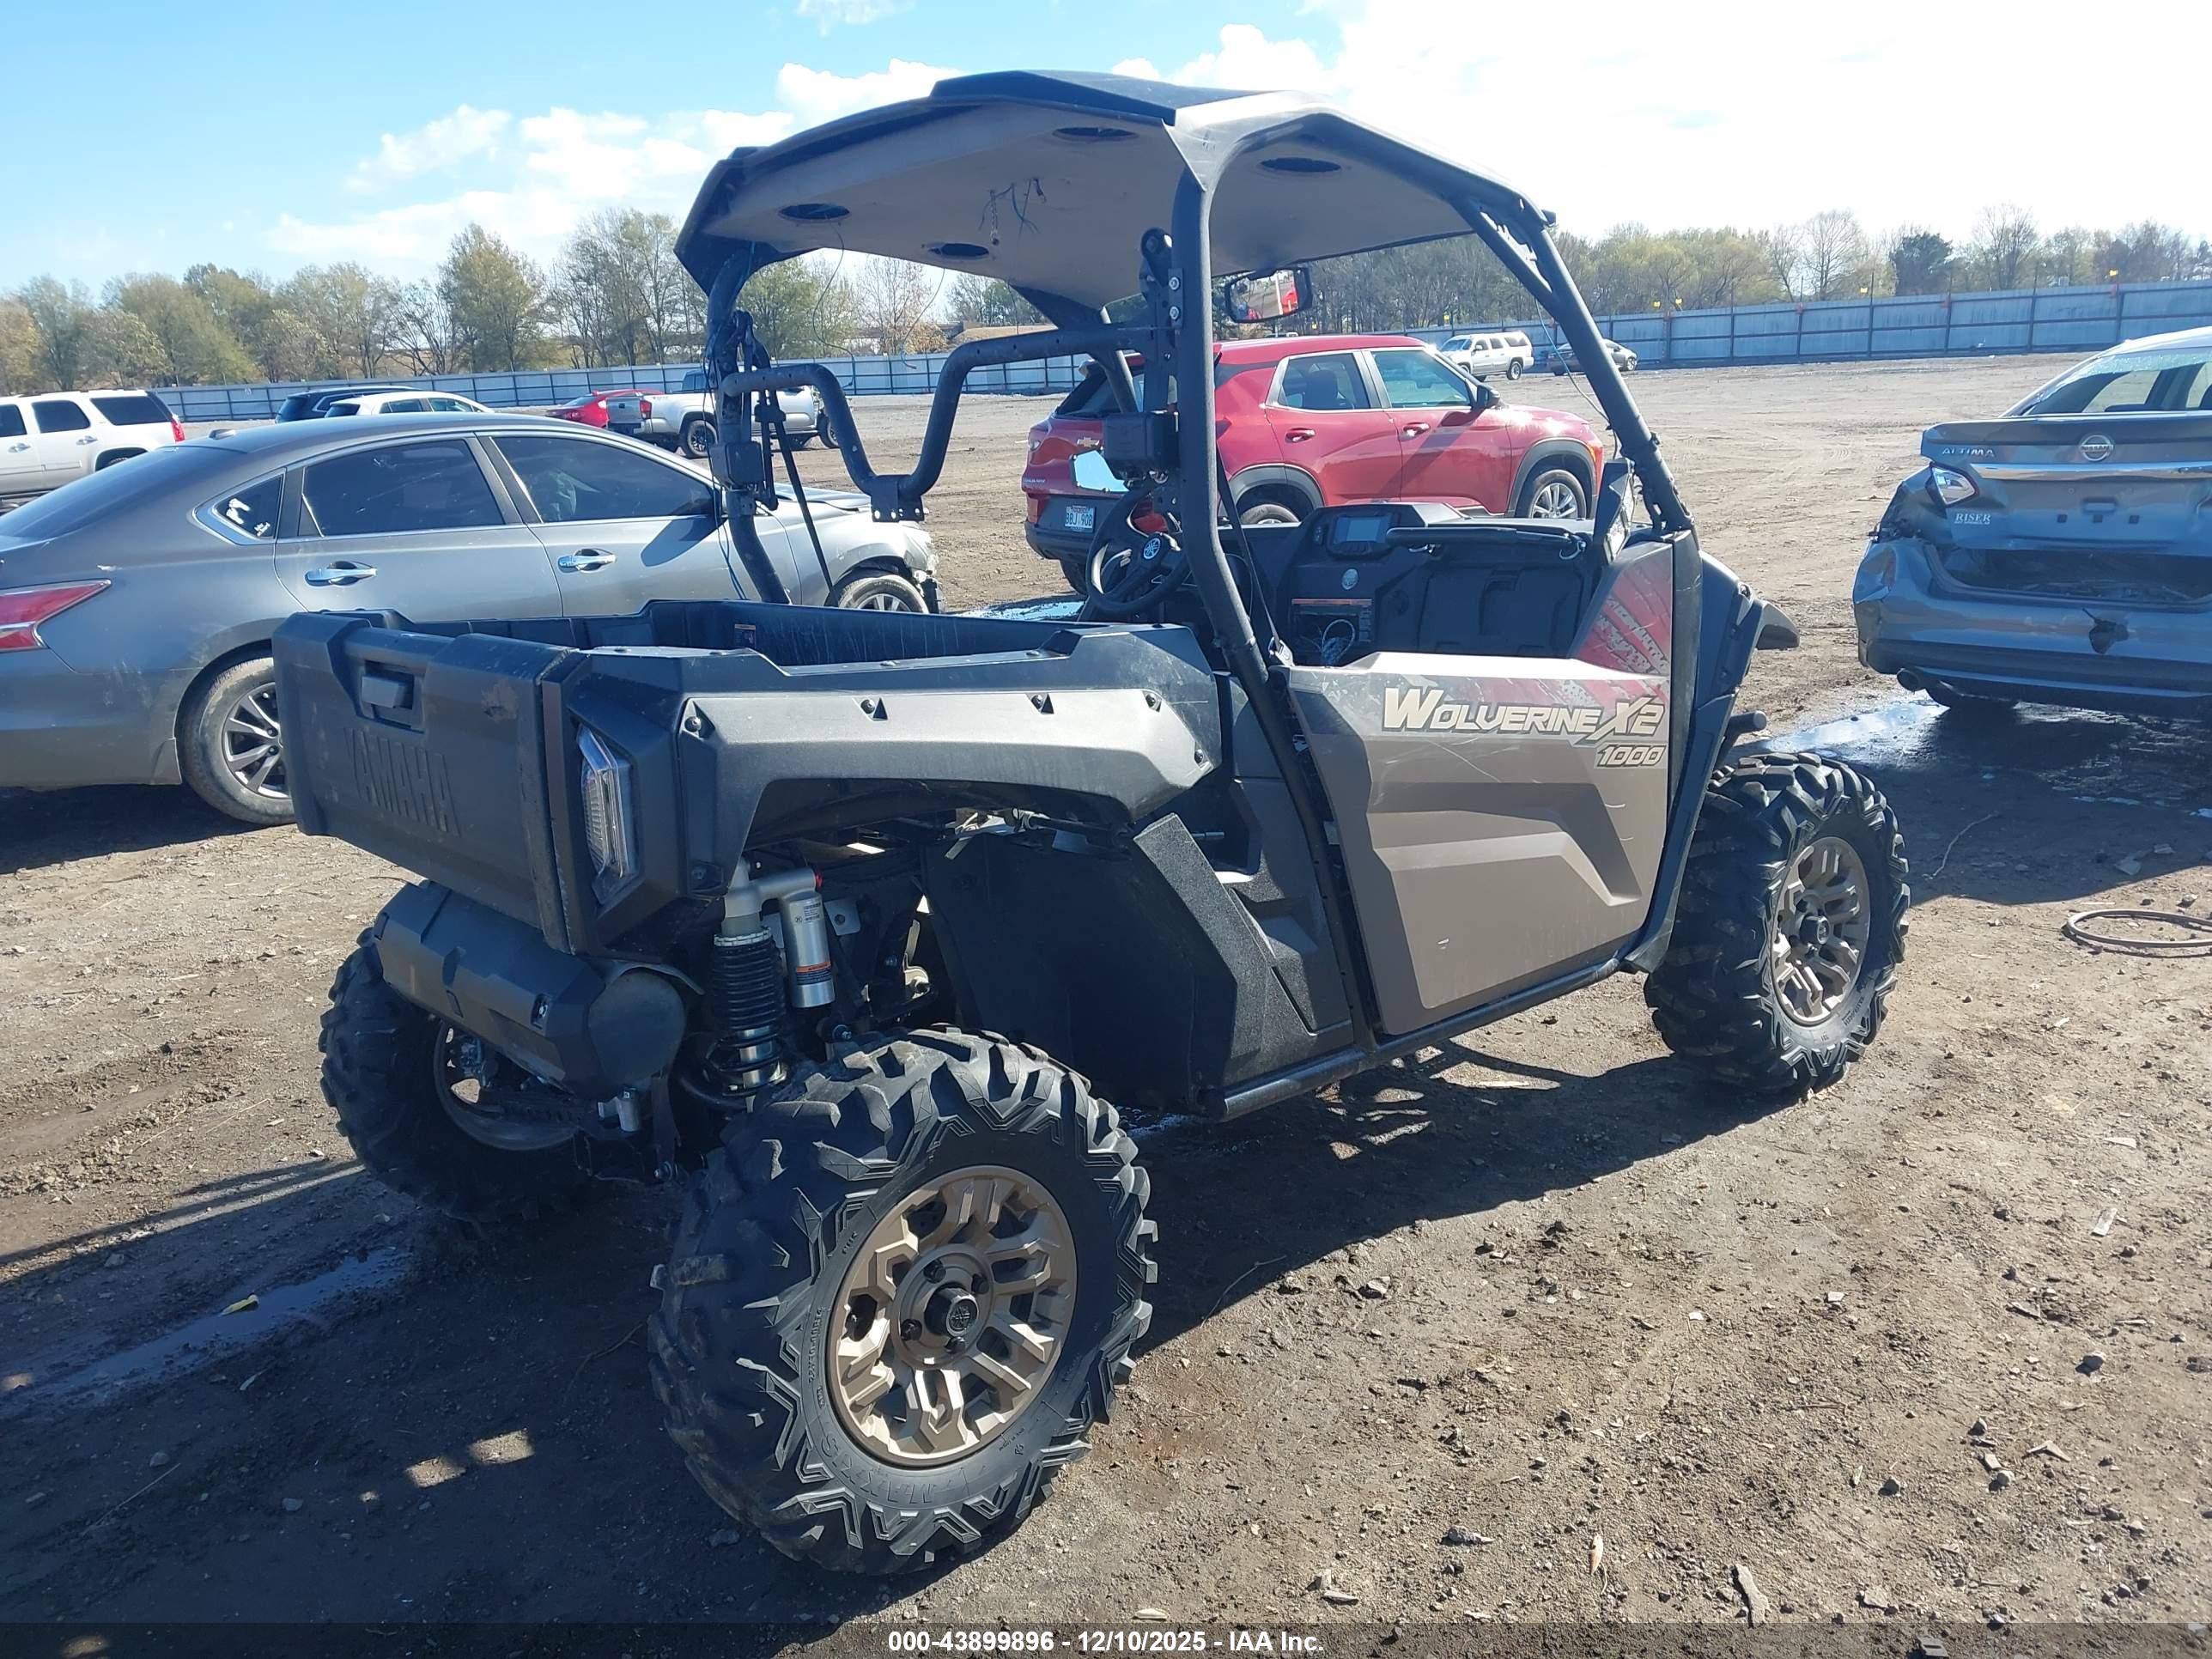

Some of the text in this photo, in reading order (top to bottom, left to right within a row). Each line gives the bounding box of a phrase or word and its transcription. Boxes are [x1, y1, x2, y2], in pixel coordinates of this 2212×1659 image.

[1942, 447, 1996, 459] ALTIMA
[1954, 513, 1991, 522] RISER
[1382, 686, 1603, 733] WOLVERINE
[1596, 744, 1667, 768] 1000
[343, 729, 461, 838] YAMAHA
